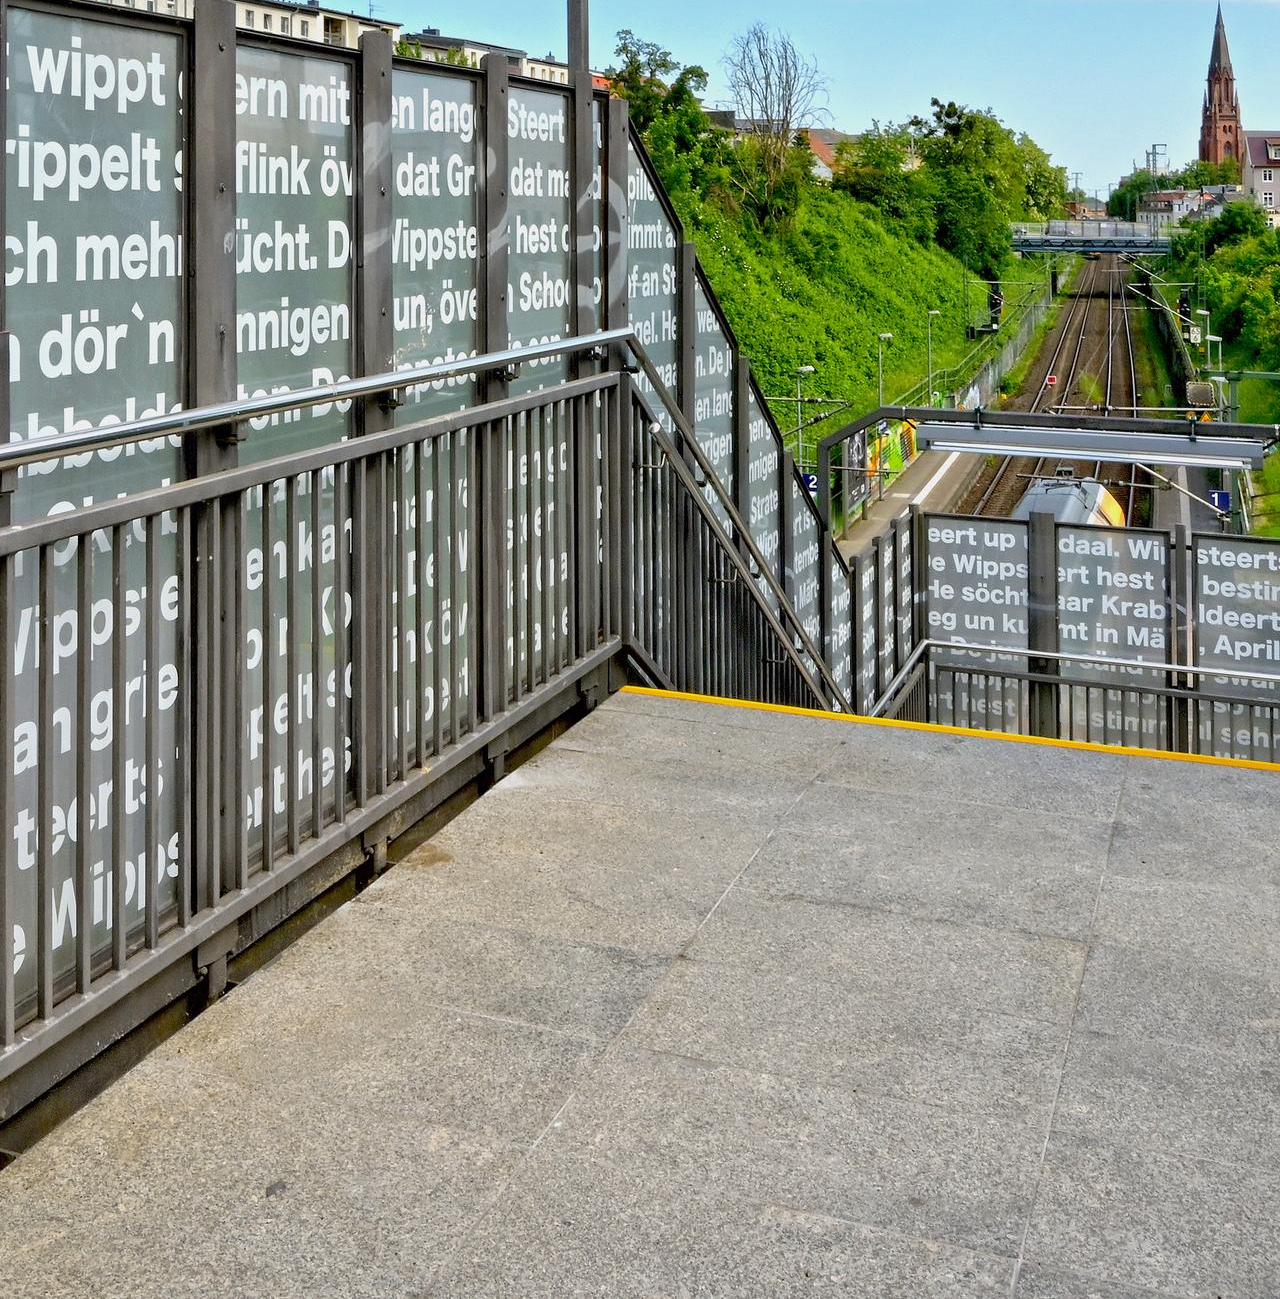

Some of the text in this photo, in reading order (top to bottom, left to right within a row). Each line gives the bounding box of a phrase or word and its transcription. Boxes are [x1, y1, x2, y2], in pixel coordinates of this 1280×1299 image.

[26, 36, 167, 114] wippt
[299, 76, 351, 126] mit
[423, 88, 477, 144] lang
[508, 97, 565, 144] Steert
[396, 152, 477, 198] dat Gr
[510, 158, 543, 198] dat
[328, 220, 353, 270] D
[516, 215, 558, 255] hest
[808, 474, 818, 489] 2
[1211, 492, 1219, 507] 1
[984, 532, 1016, 551] up
[961, 583, 1029, 607] söcht
[1097, 566, 1154, 591] hest
[964, 614, 995, 631] un
[1102, 594, 1166, 620] Krab
[1096, 623, 1119, 644] in
